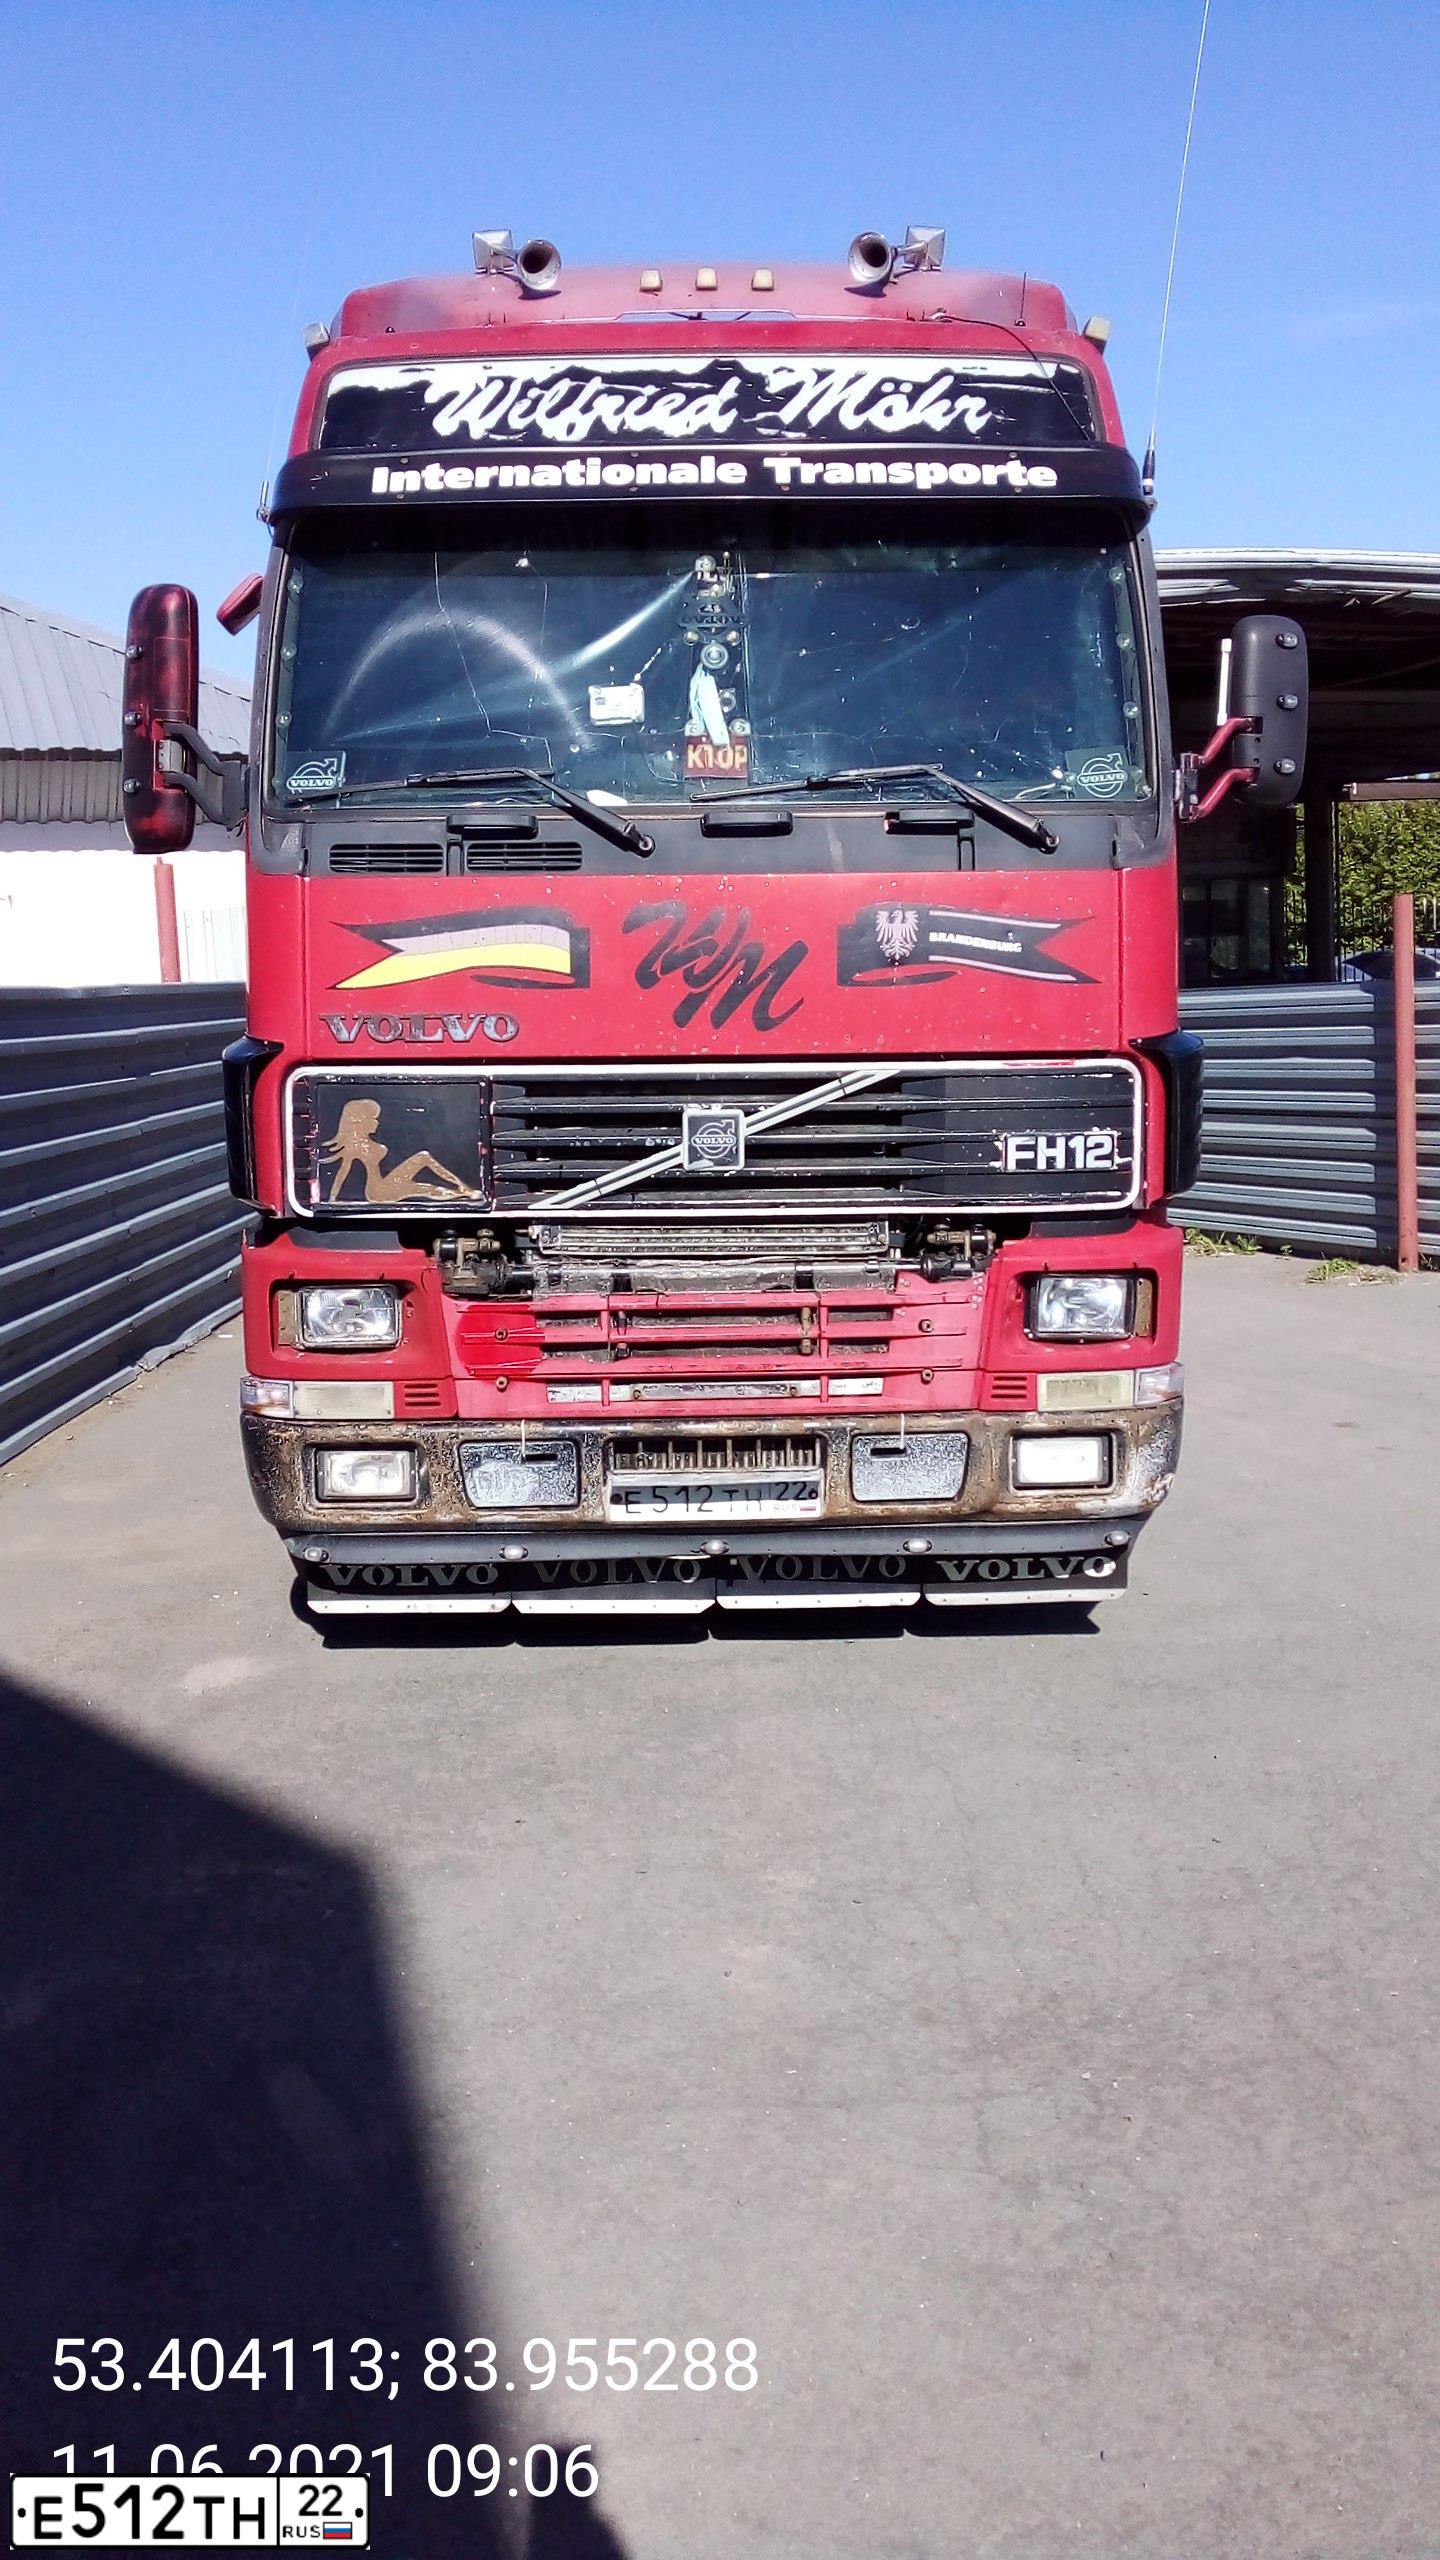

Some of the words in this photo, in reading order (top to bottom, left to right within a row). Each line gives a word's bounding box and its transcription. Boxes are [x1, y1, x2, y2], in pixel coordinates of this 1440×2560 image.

[371, 456, 749, 494] Internationale
[763, 456, 1058, 489] Transporte
[290, 779, 334, 787] VOLVO
[1080, 773, 1125, 784] VOLVO
[929, 932, 1022, 952] BRANDENBURG
[319, 1012, 520, 1043] VOLVO
[1005, 1136, 1115, 1171] FH12
[774, 1480, 808, 1500] 22
[322, 1564, 500, 1586] VOLVO
[533, 1557, 702, 1584] VOLVO
[738, 1555, 907, 1581] VOLVO
[936, 1556, 1117, 1581] VOLVO
